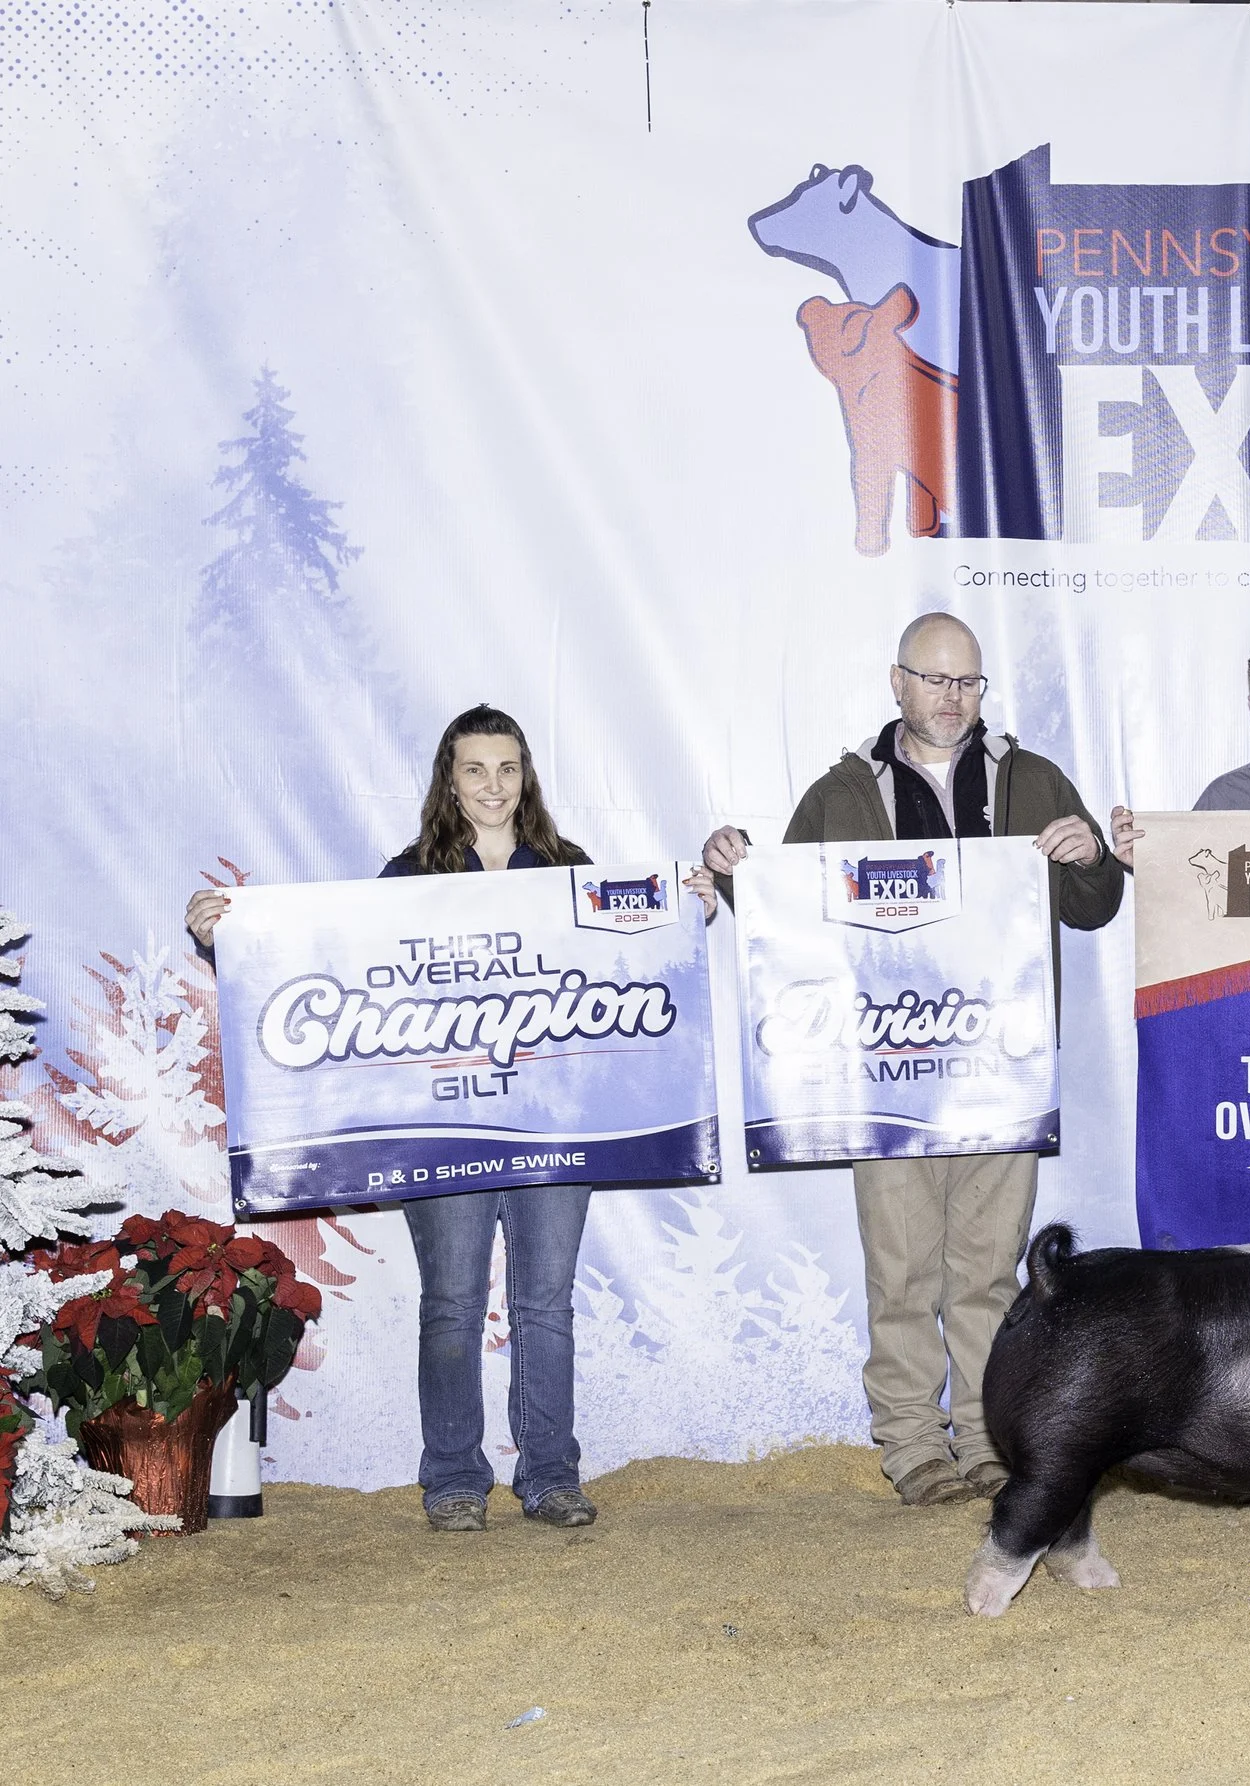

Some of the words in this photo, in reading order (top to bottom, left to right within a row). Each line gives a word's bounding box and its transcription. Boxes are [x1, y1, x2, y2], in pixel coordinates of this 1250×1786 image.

[1034, 286, 1209, 353] YOUTH
[953, 565, 1087, 593] Connecting
[1095, 566, 1198, 592] together
[866, 871, 886, 880] YOUTH
[887, 870, 918, 879] LIVESTOCK
[869, 878, 918, 900] EXPO
[609, 894, 648, 910] EXPO
[875, 906, 919, 917] 2023
[615, 914, 648, 922] 2023
[399, 932, 522, 961] THIRD
[367, 954, 561, 989] OVERALL
[257, 969, 676, 1073] Champion
[432, 1071, 518, 1101] GILT
[368, 1172, 384, 1186] D
[391, 1169, 406, 1184] &
[413, 1168, 429, 1182] D
[435, 1158, 505, 1180] SHOW
[511, 1152, 586, 1170] SWINE
